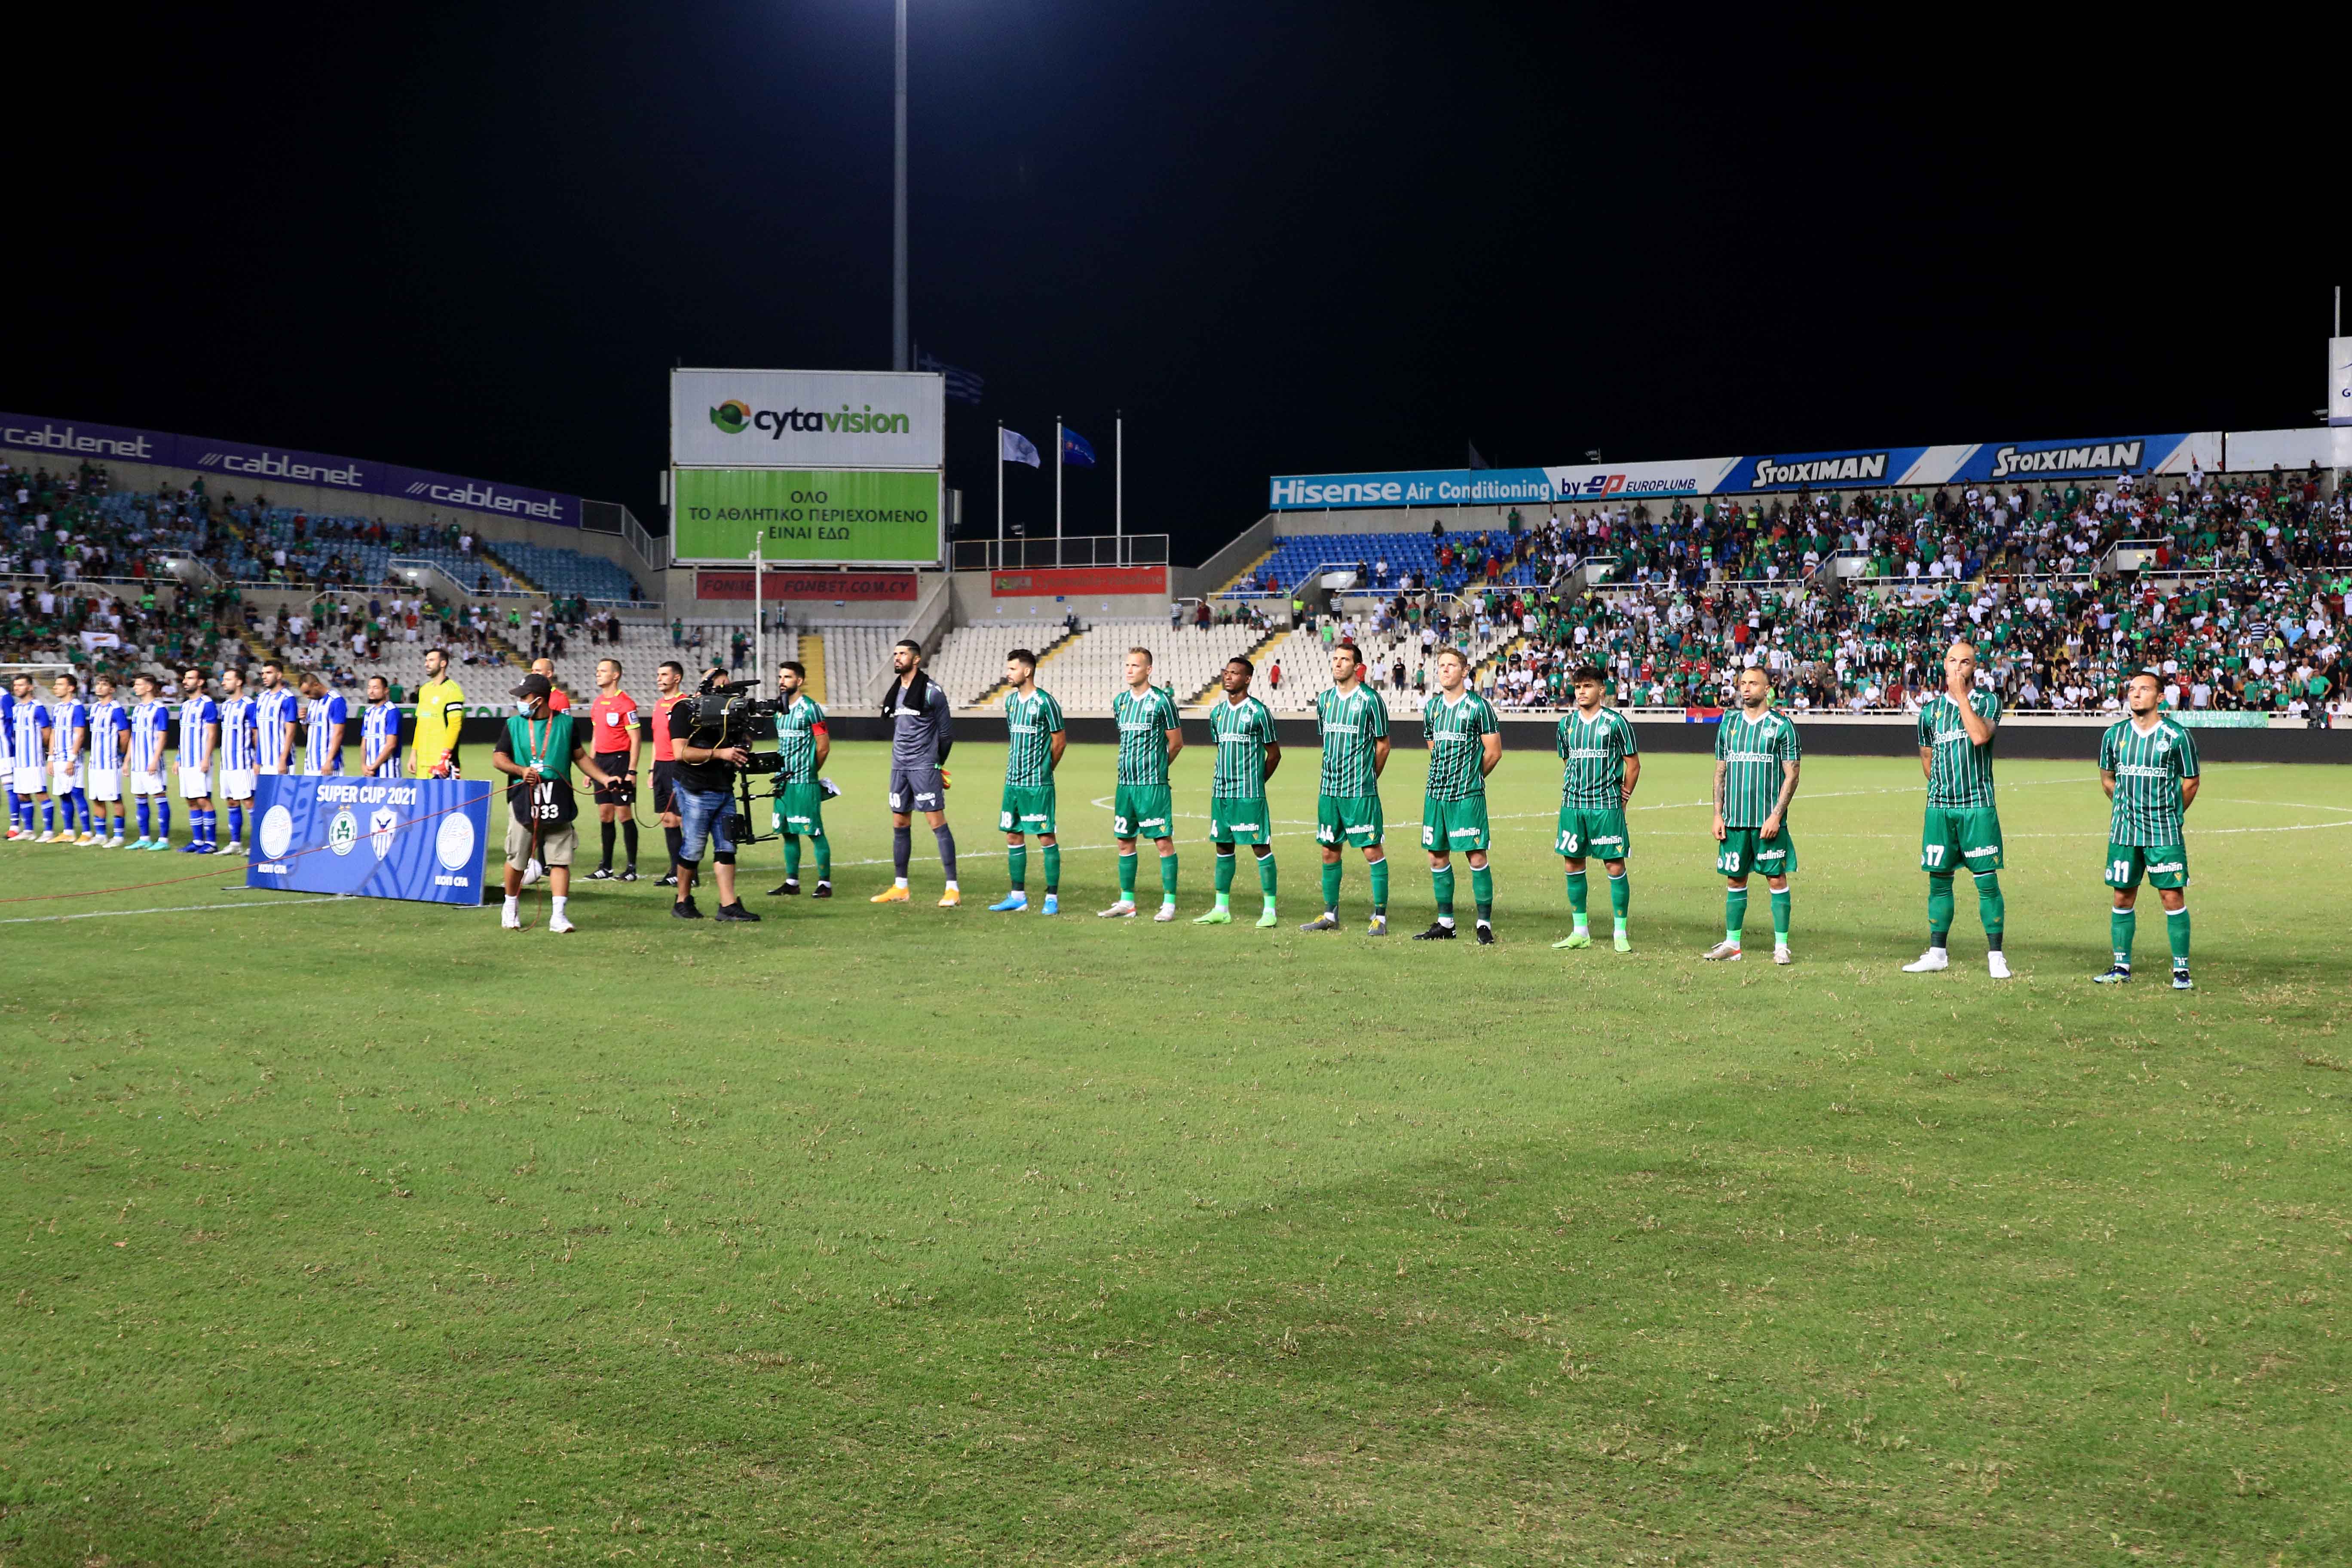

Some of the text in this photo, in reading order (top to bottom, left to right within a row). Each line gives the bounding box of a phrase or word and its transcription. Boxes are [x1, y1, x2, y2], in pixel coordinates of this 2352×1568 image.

[754, 404, 909, 439] cytavision
[4, 425, 152, 459] cablenet
[224, 453, 363, 487] cablenet
[1752, 454, 1885, 488] STOIXIMAN
[1993, 442, 2141, 477] STOIXIMAN
[430, 484, 563, 520] cablenet
[791, 491, 827, 503] ΟΛΟ
[1271, 480, 1401, 505] Hisense
[1406, 483, 1433, 500] Air
[1439, 479, 1550, 502] Conditioning
[1562, 478, 1580, 499] by
[1626, 478, 1696, 492] EUROPLUMB
[689, 508, 928, 523] ΤΟ ΑΘΛΗΤΙΚΟ ΠΕΡΙΕΧΟΜΕΝΟ
[769, 527, 850, 539] ΕΙΝΑΙ ΕΔΩ
[316, 784, 416, 805] SUPER CUP 2021
[1114, 815, 1128, 834] 22
[1210, 819, 1218, 838] 4
[1320, 824, 1335, 843] 44
[1422, 825, 1433, 846] 15
[1559, 830, 1578, 853] 76
[1926, 844, 1945, 867] 17
[2113, 860, 2129, 883] 11
